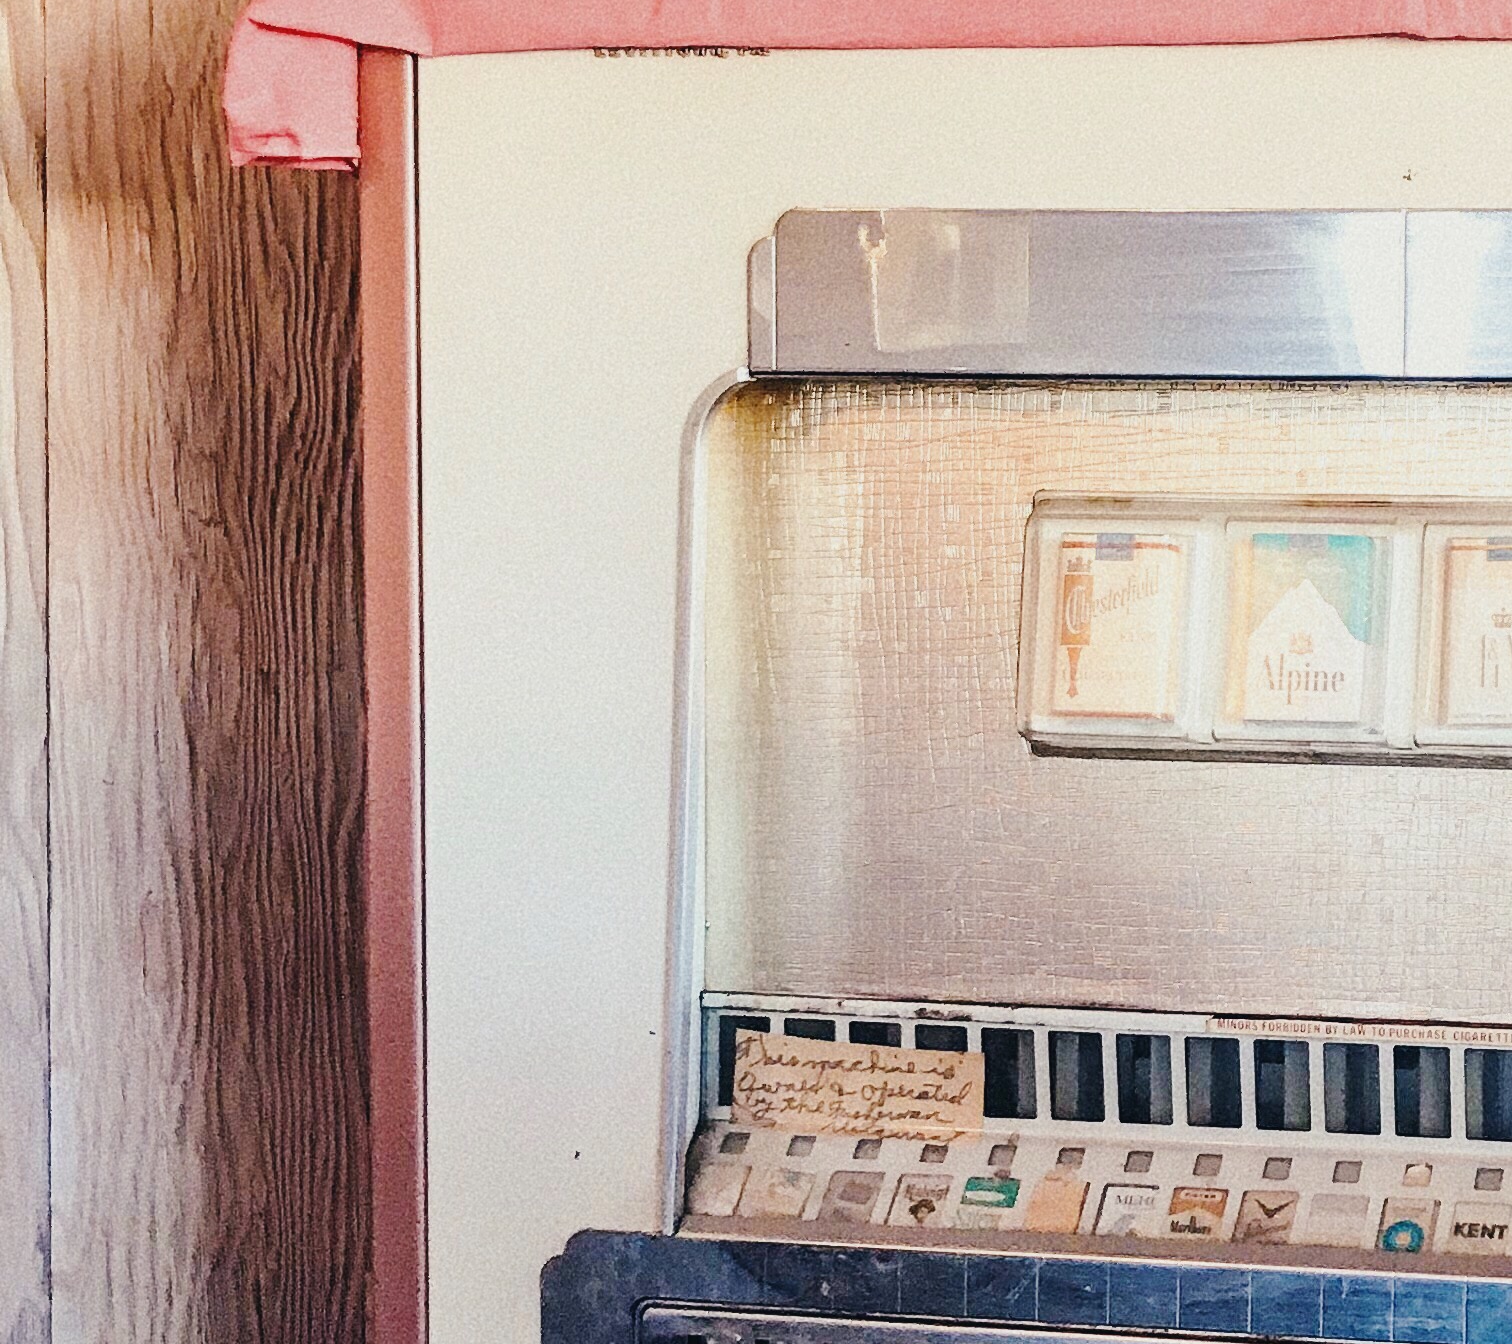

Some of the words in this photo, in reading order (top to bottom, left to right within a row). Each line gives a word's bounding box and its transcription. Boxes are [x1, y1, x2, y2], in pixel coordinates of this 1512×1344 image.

[1066, 565, 1159, 635] Chesterfield
[1256, 653, 1345, 705] Alpine
[1217, 1019, 1259, 1032] MINORS
[1261, 1021, 1321, 1034] FORBIDDEN
[1325, 1024, 1338, 1036] BY
[1342, 1024, 1367, 1036] LAW
[1371, 1026, 1387, 1038] TO
[1389, 1027, 1447, 1040] PURCHASE
[1453, 1221, 1508, 1240] KENT
